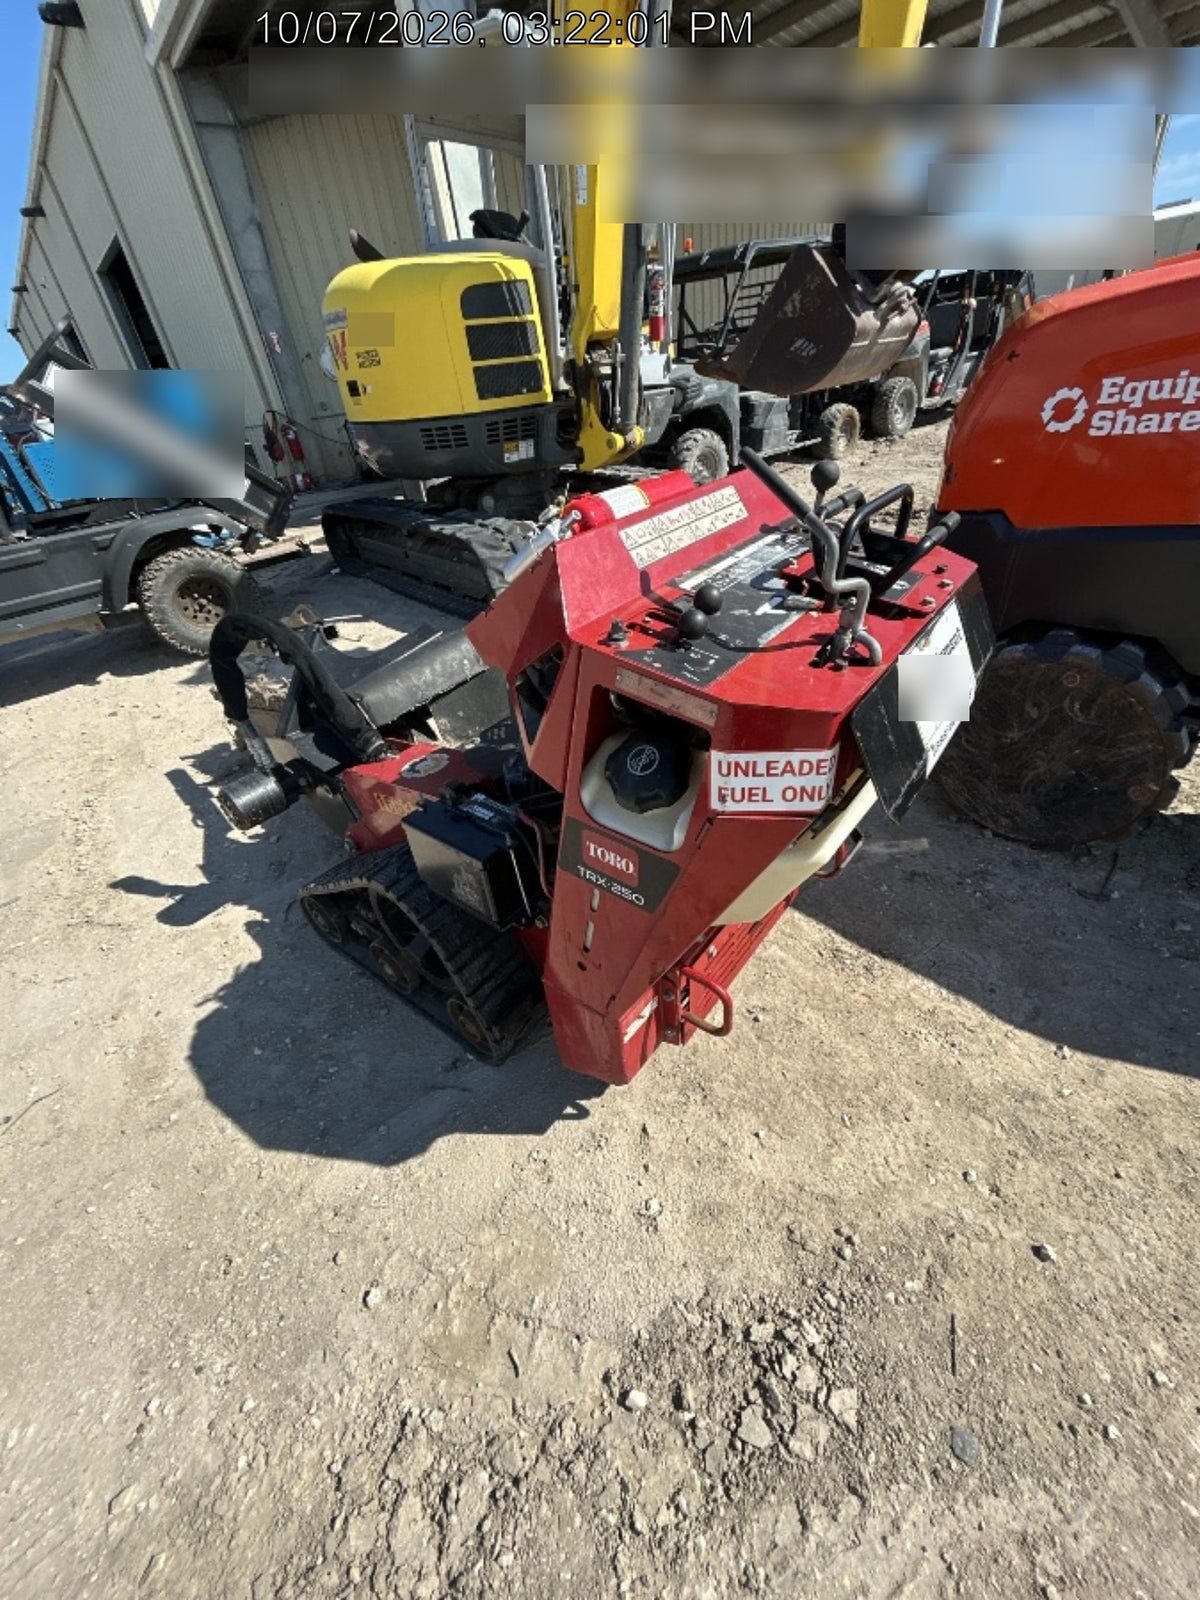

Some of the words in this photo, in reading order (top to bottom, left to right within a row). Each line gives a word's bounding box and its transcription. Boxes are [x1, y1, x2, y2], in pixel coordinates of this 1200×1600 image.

[1088, 409, 1200, 436] Share
[717, 786, 774, 804] FUEL
[586, 840, 636, 874] TORO
[577, 865, 645, 906] TRX-250
